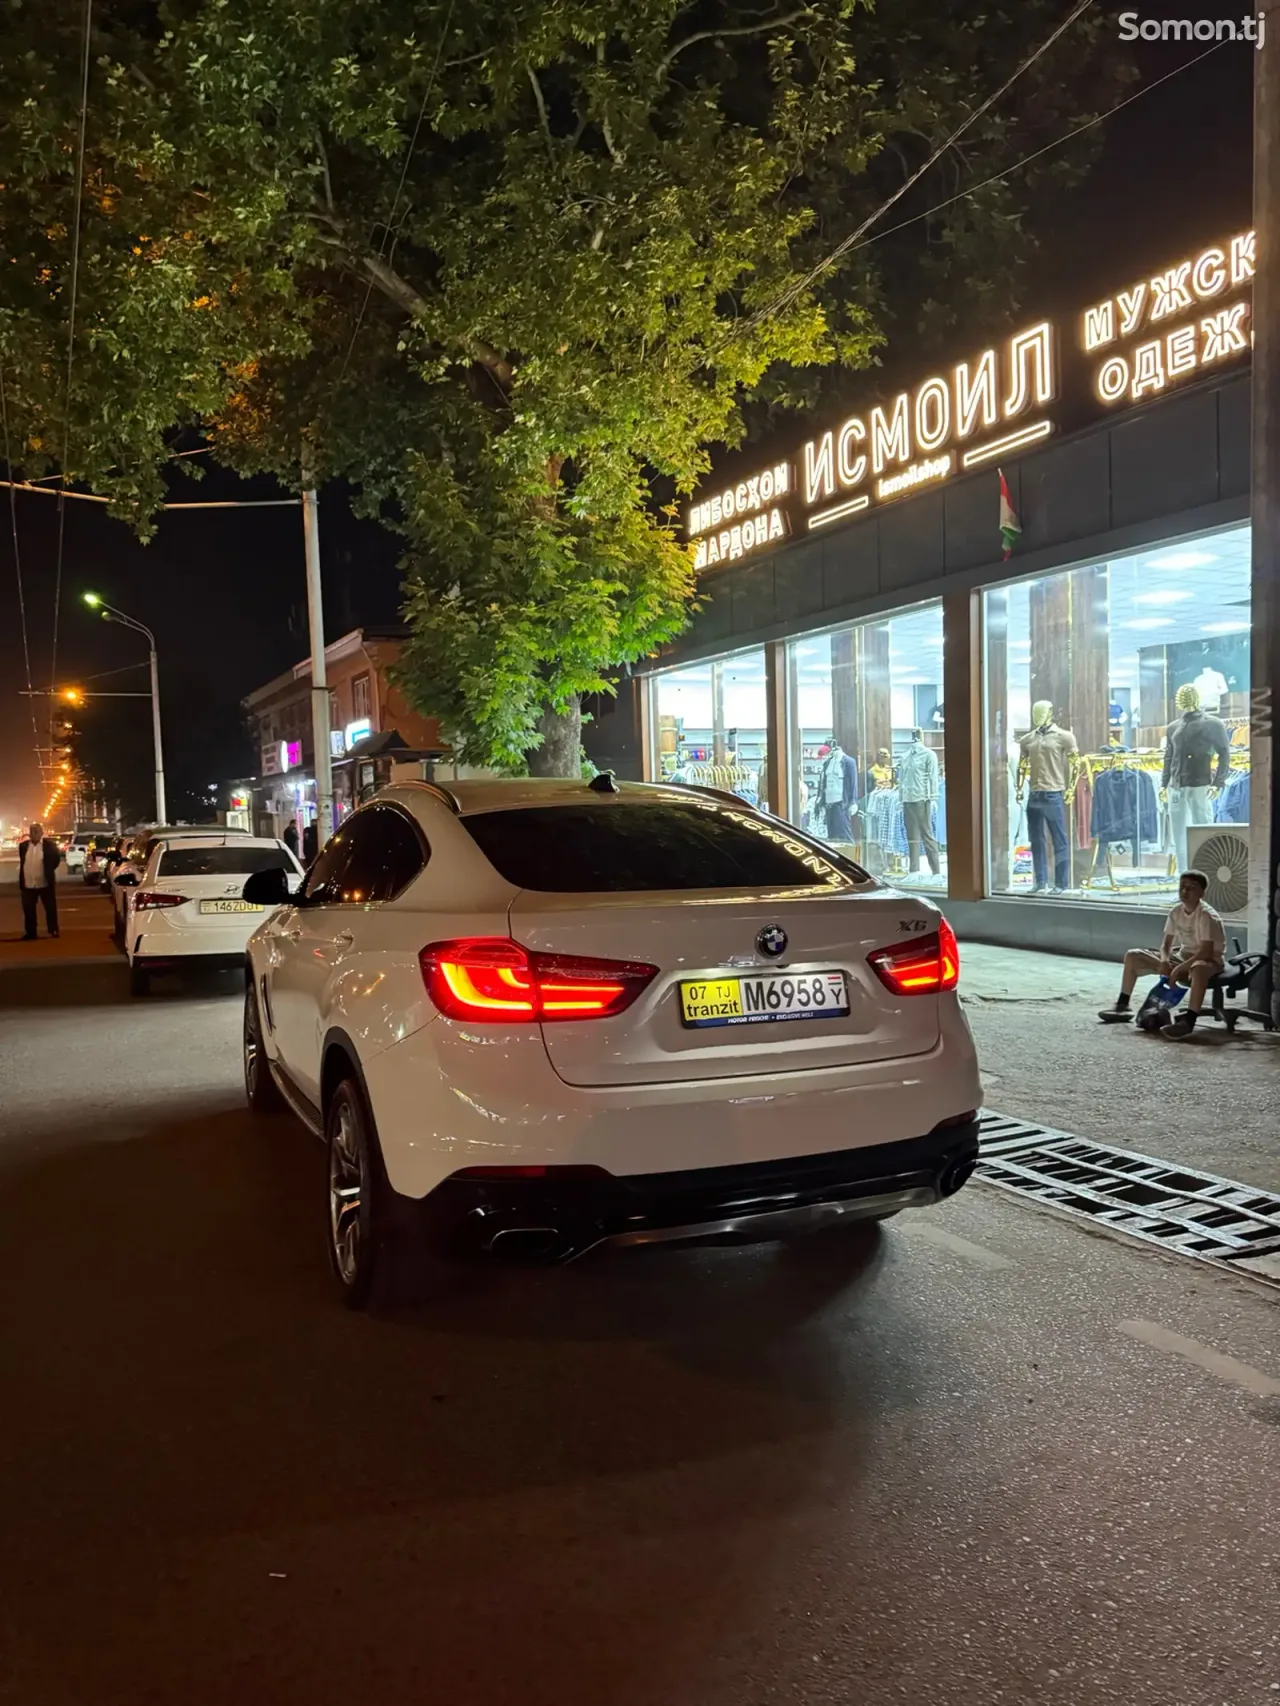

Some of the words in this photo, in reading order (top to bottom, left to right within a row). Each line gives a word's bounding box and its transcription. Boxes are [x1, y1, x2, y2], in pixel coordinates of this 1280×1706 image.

[1098, 302, 1255, 401] ОДЕЖ
[804, 322, 1051, 504] ИСМОИЛ
[896, 919, 927, 932] X6
[689, 986, 707, 1001] 07
[716, 986, 731, 998] TJ
[744, 978, 826, 1011] M6958
[686, 1000, 739, 1017] tranzit
